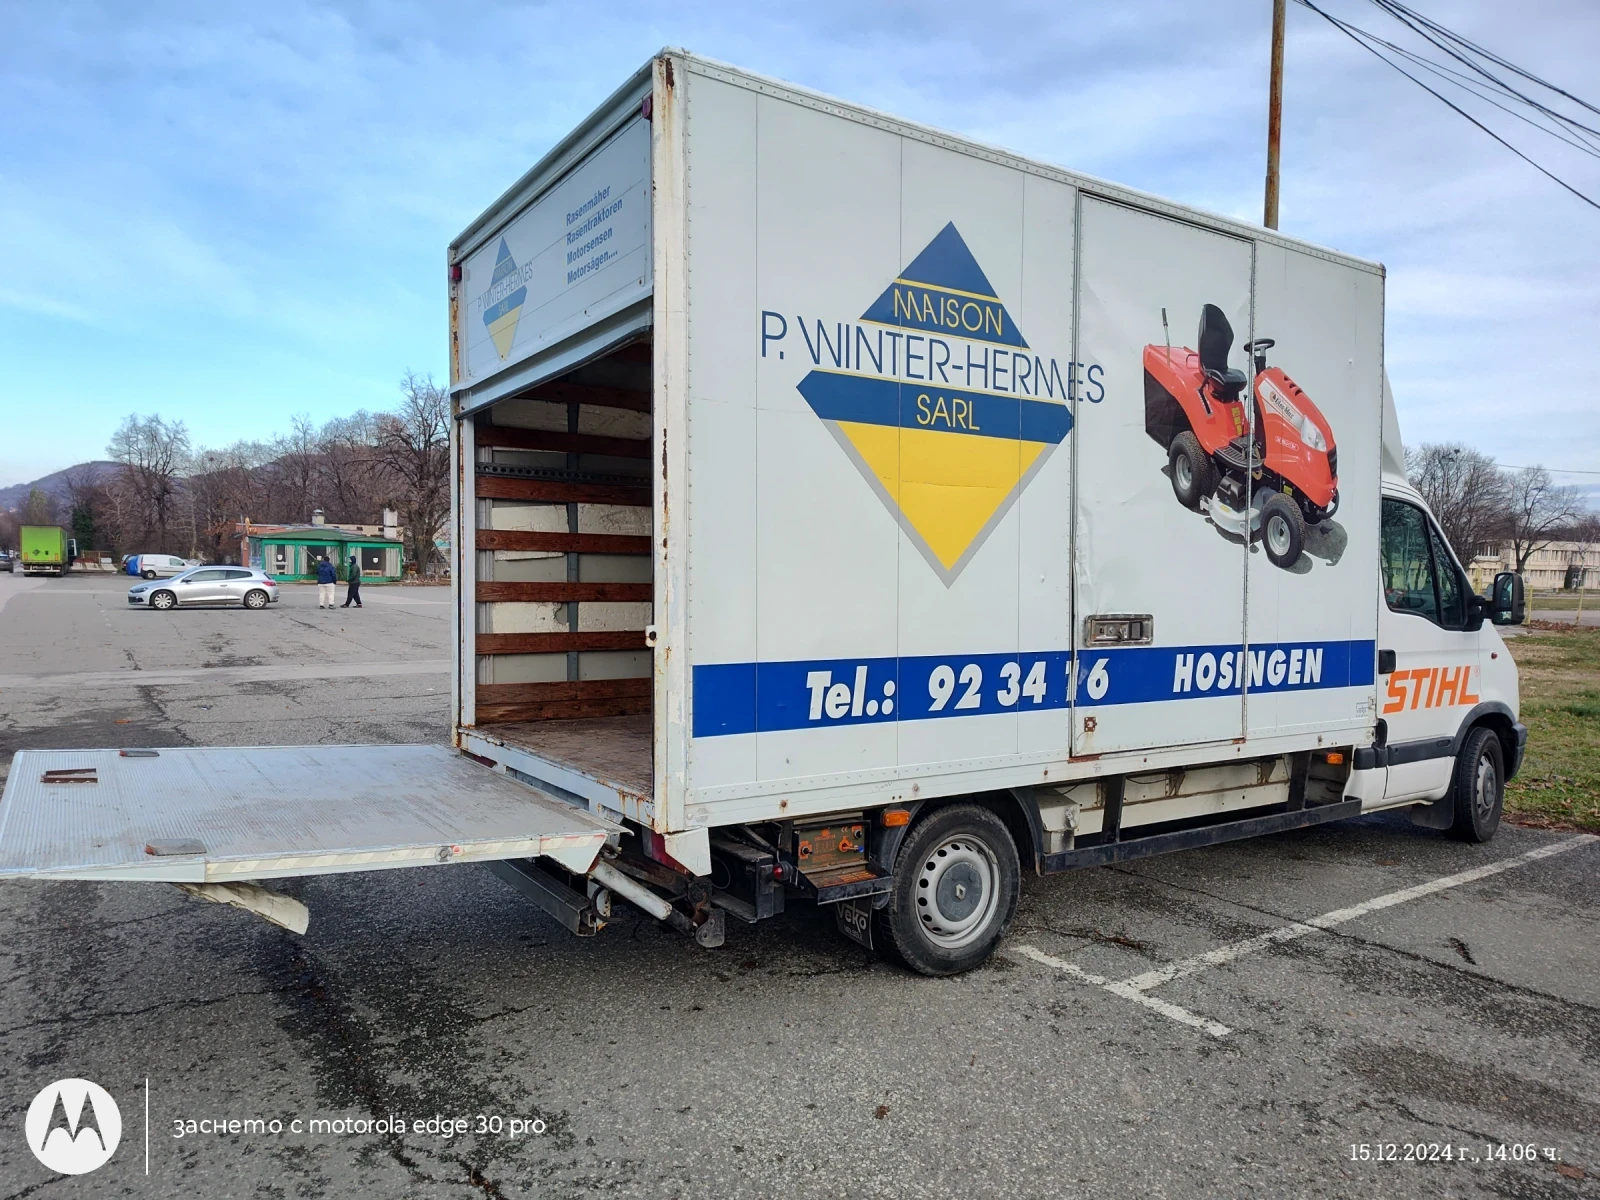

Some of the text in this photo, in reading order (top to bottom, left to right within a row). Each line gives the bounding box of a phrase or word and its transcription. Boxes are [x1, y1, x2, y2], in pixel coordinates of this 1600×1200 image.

[566, 185, 611, 226] Rasenmäher
[566, 198, 623, 246] Rasentraktoren
[566, 226, 613, 265] Motorsensen
[894, 288, 1003, 336] MAISON
[761, 310, 1105, 404] P. WINTER-HERMES
[916, 394, 980, 431] SARL
[806, 665, 896, 720] Tel.:
[928, 663, 983, 711] 92
[997, 661, 1047, 706] 34
[1172, 648, 1323, 693] HOSINGEN
